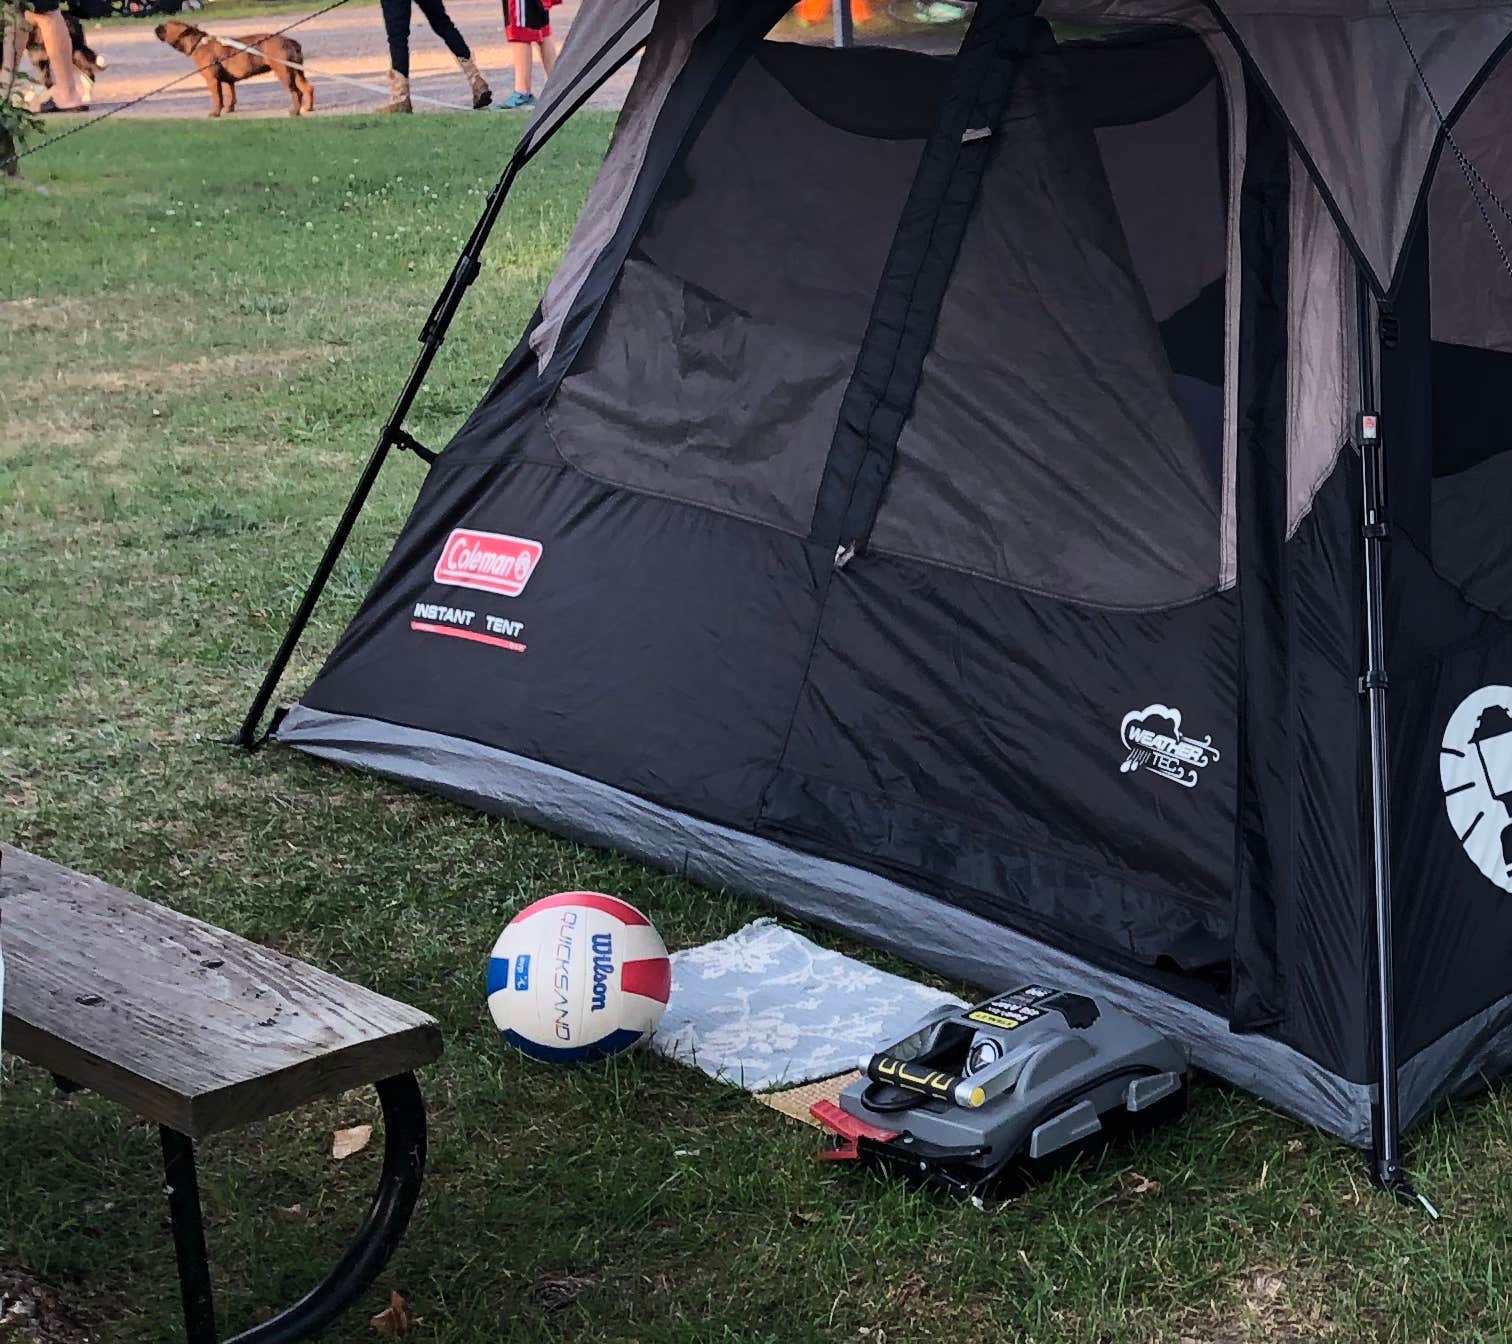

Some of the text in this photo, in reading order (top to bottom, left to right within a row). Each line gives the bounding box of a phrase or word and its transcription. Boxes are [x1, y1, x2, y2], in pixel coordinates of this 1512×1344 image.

[447, 537, 516, 577] Coleman
[413, 602, 525, 638] INSTANT TENT
[1128, 725, 1204, 762] WEATHER
[1152, 751, 1180, 773] TEC
[553, 910, 578, 1042] QUICKSAND
[590, 932, 616, 1014] Wilson
